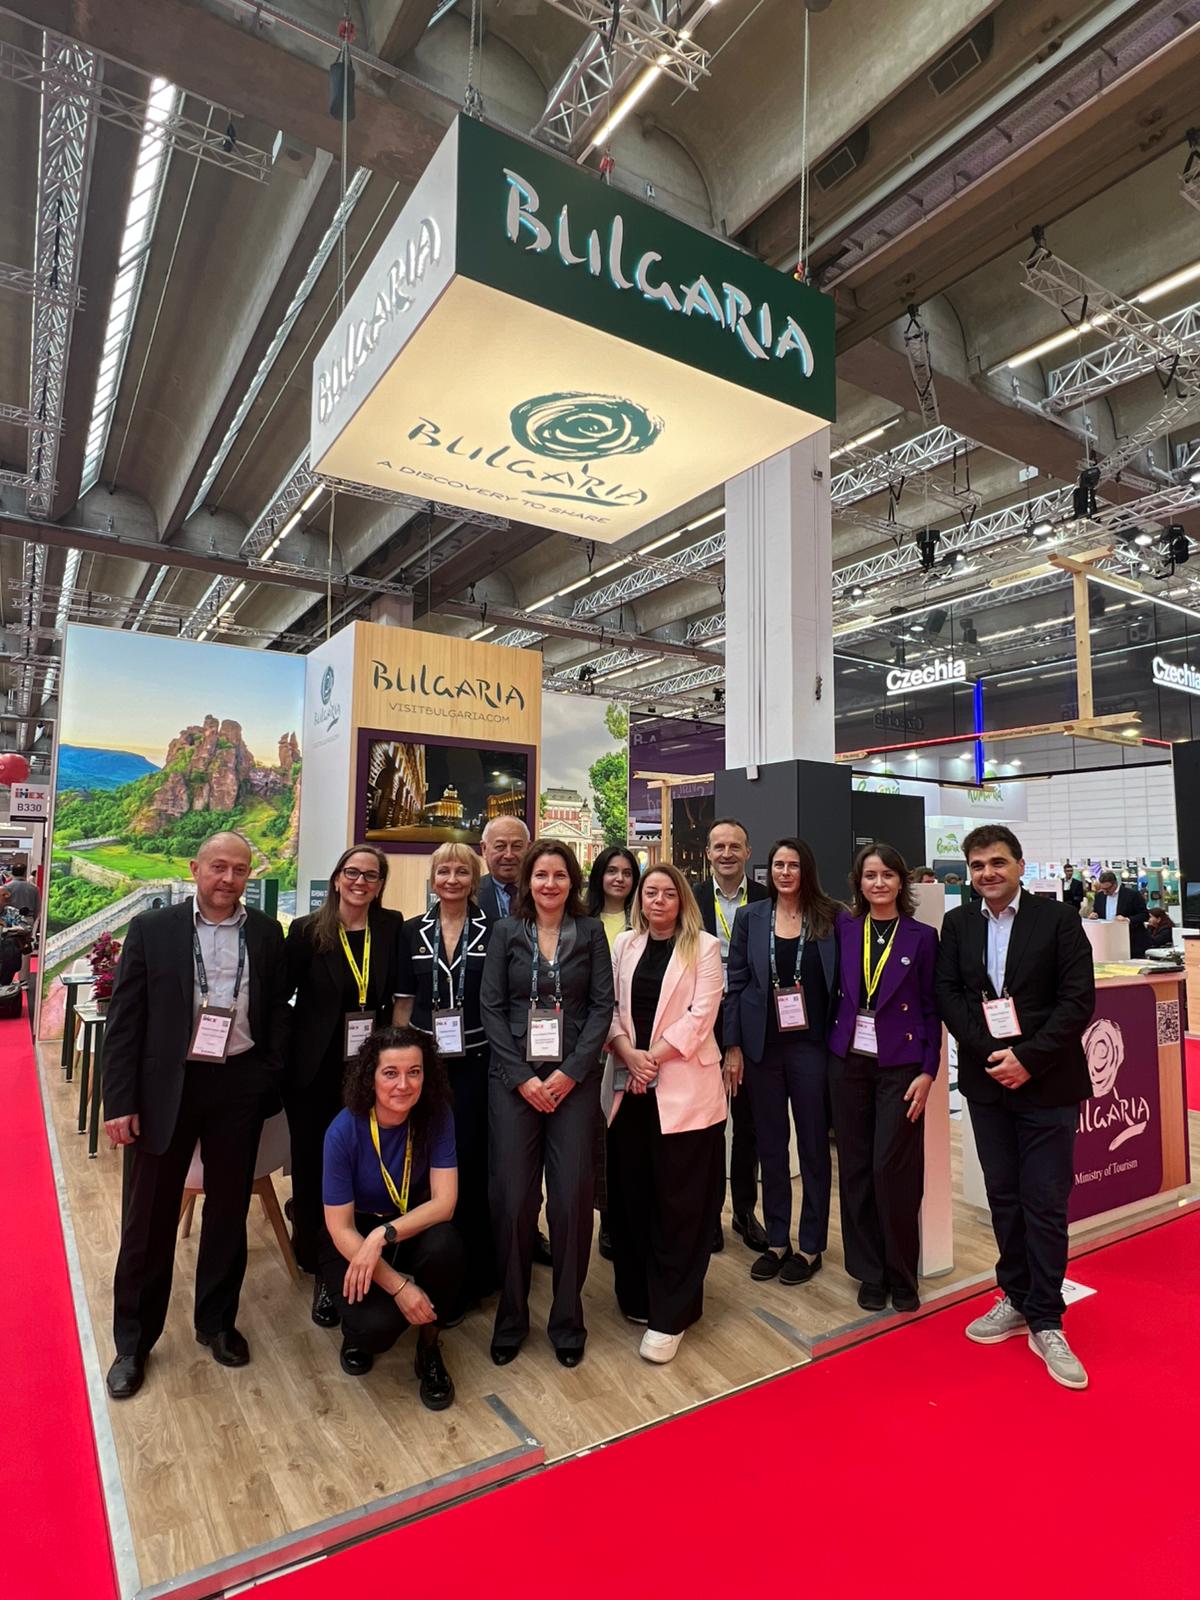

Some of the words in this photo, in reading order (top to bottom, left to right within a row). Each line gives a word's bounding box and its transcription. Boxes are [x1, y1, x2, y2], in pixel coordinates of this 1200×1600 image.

[503, 168, 815, 378] BULGARIA
[319, 216, 441, 425] BULGARIA
[407, 416, 648, 506] BULGARIA
[377, 459, 393, 469] A
[400, 466, 518, 501] DISCOVERY
[523, 499, 546, 510] TO
[550, 507, 611, 524] SHARE
[371, 660, 526, 711] BULGARIA
[886, 656, 967, 691] Czechia
[17, 803, 42, 813] B330
[1074, 1169, 1104, 1185] Ministry
[1104, 1163, 1113, 1176] of
[1113, 1159, 1139, 1174] Tourism
